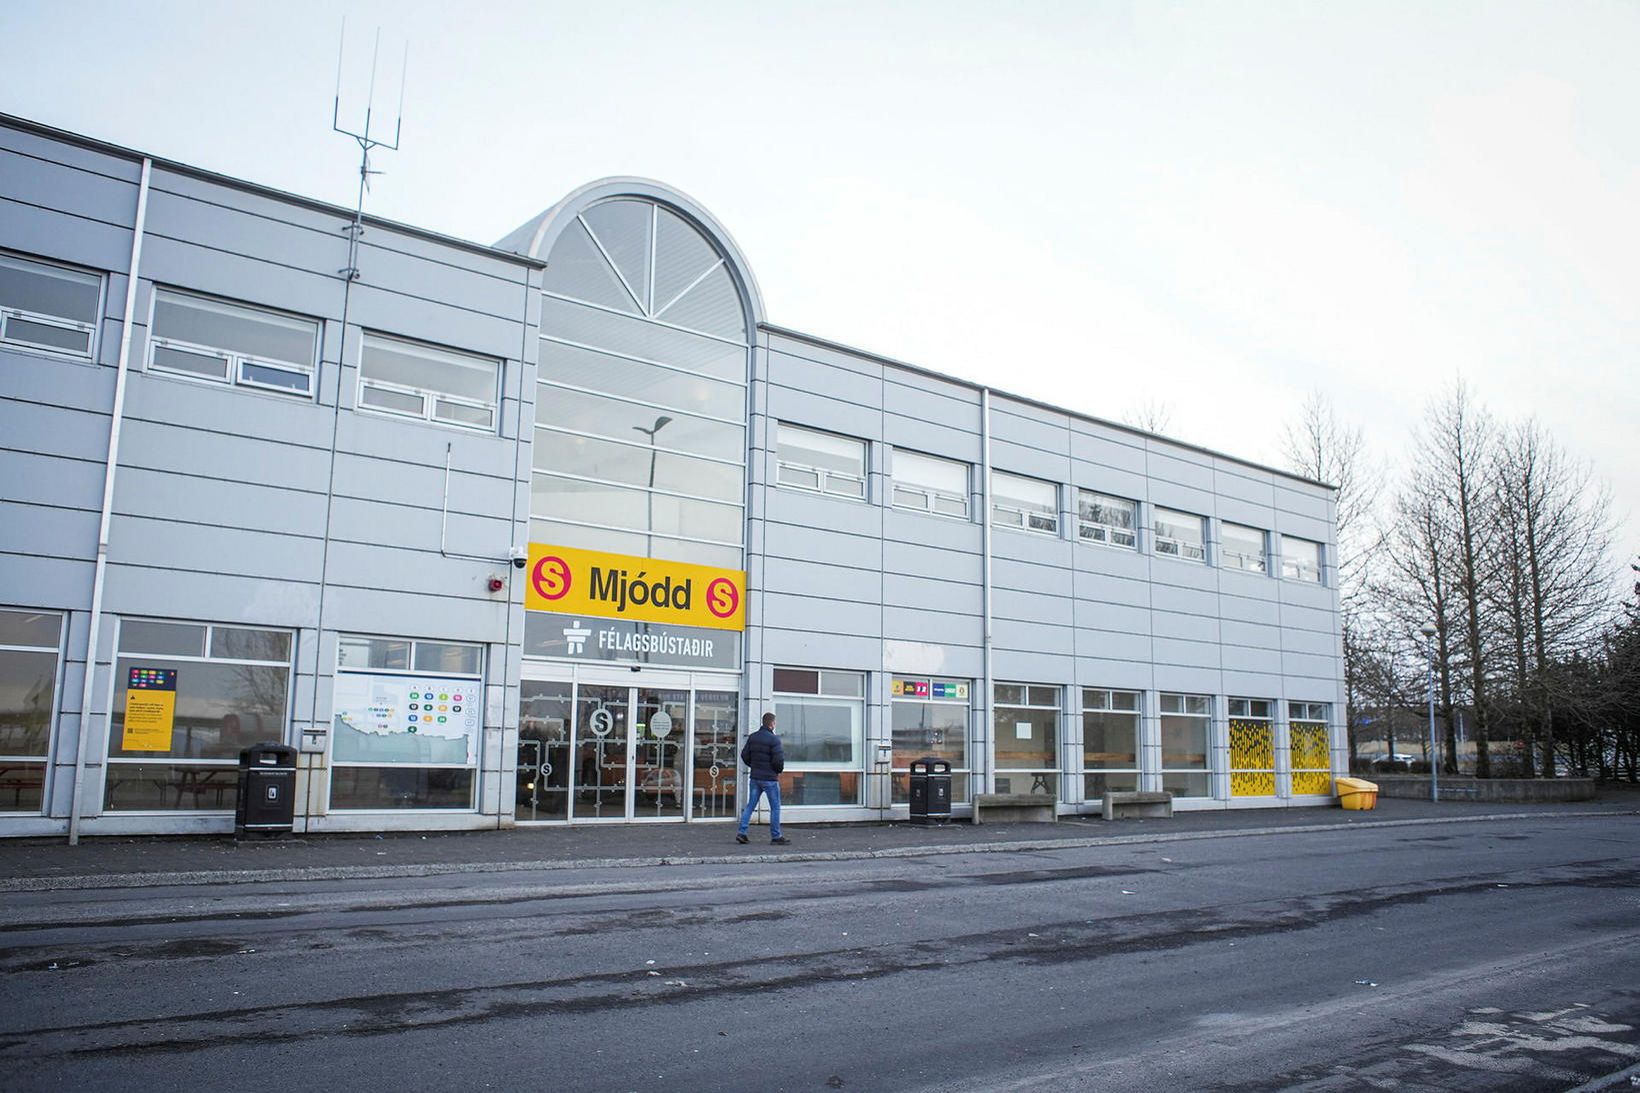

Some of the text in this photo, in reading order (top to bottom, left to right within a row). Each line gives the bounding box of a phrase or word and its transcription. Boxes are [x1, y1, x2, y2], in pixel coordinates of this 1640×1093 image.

[540, 559, 734, 614] S Mjódd S
[599, 627, 713, 657] FÉLAGSBÚSTAÐIR
[595, 712, 609, 732] S
